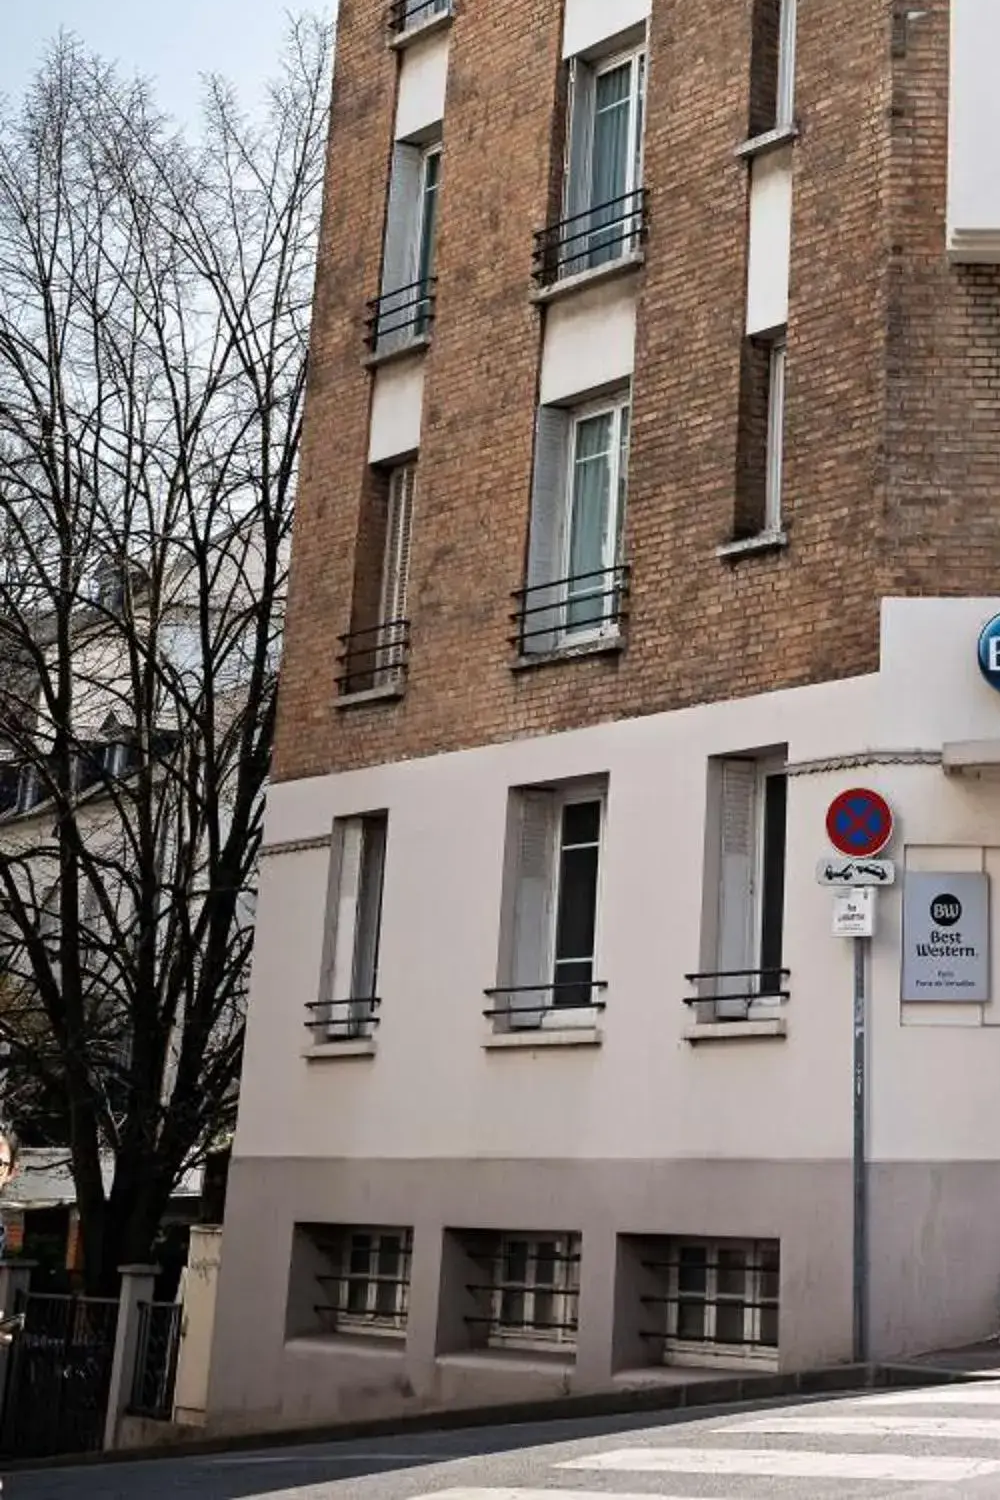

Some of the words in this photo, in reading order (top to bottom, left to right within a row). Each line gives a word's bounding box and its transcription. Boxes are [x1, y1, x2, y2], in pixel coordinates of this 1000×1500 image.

[933, 903, 959, 919] BW
[931, 930, 962, 944] Best
[916, 943, 976, 957] Western
